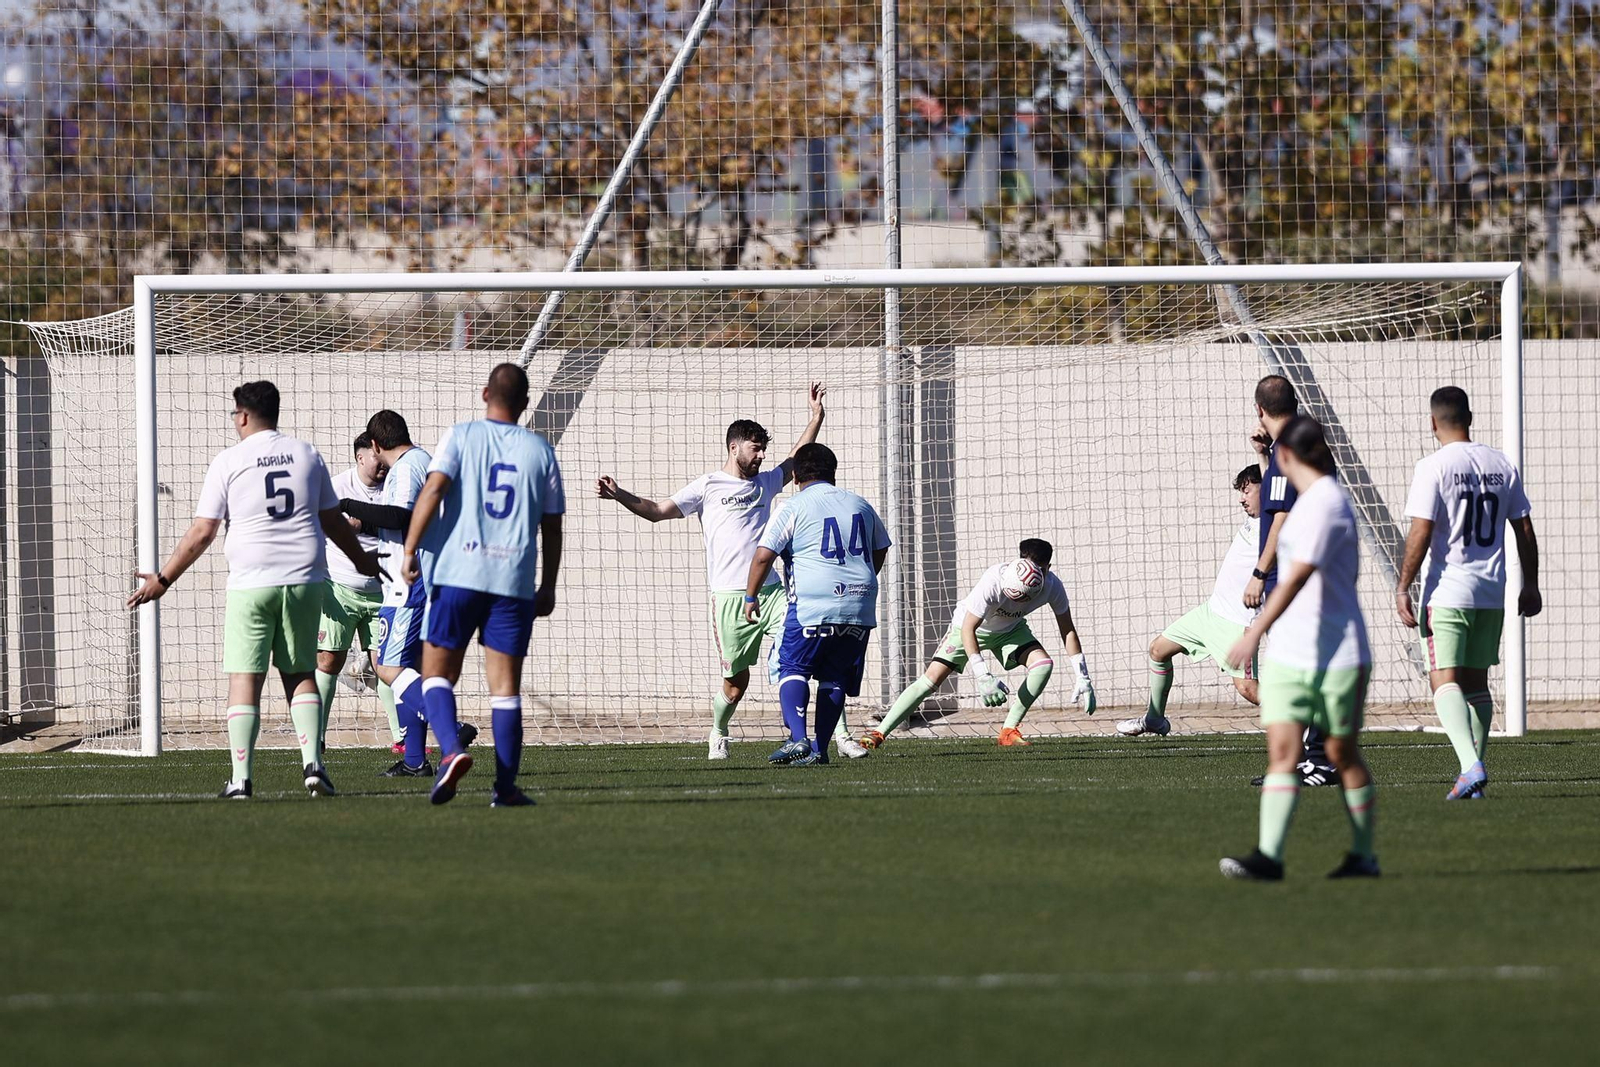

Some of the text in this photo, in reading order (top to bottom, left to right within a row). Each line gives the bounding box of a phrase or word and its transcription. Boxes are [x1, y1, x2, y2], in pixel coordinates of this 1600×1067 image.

[257, 452, 294, 467] ADRIÁN
[264, 470, 295, 520] 5
[484, 463, 518, 519] 5
[820, 512, 871, 565] 44
[1459, 490, 1499, 548] 10
